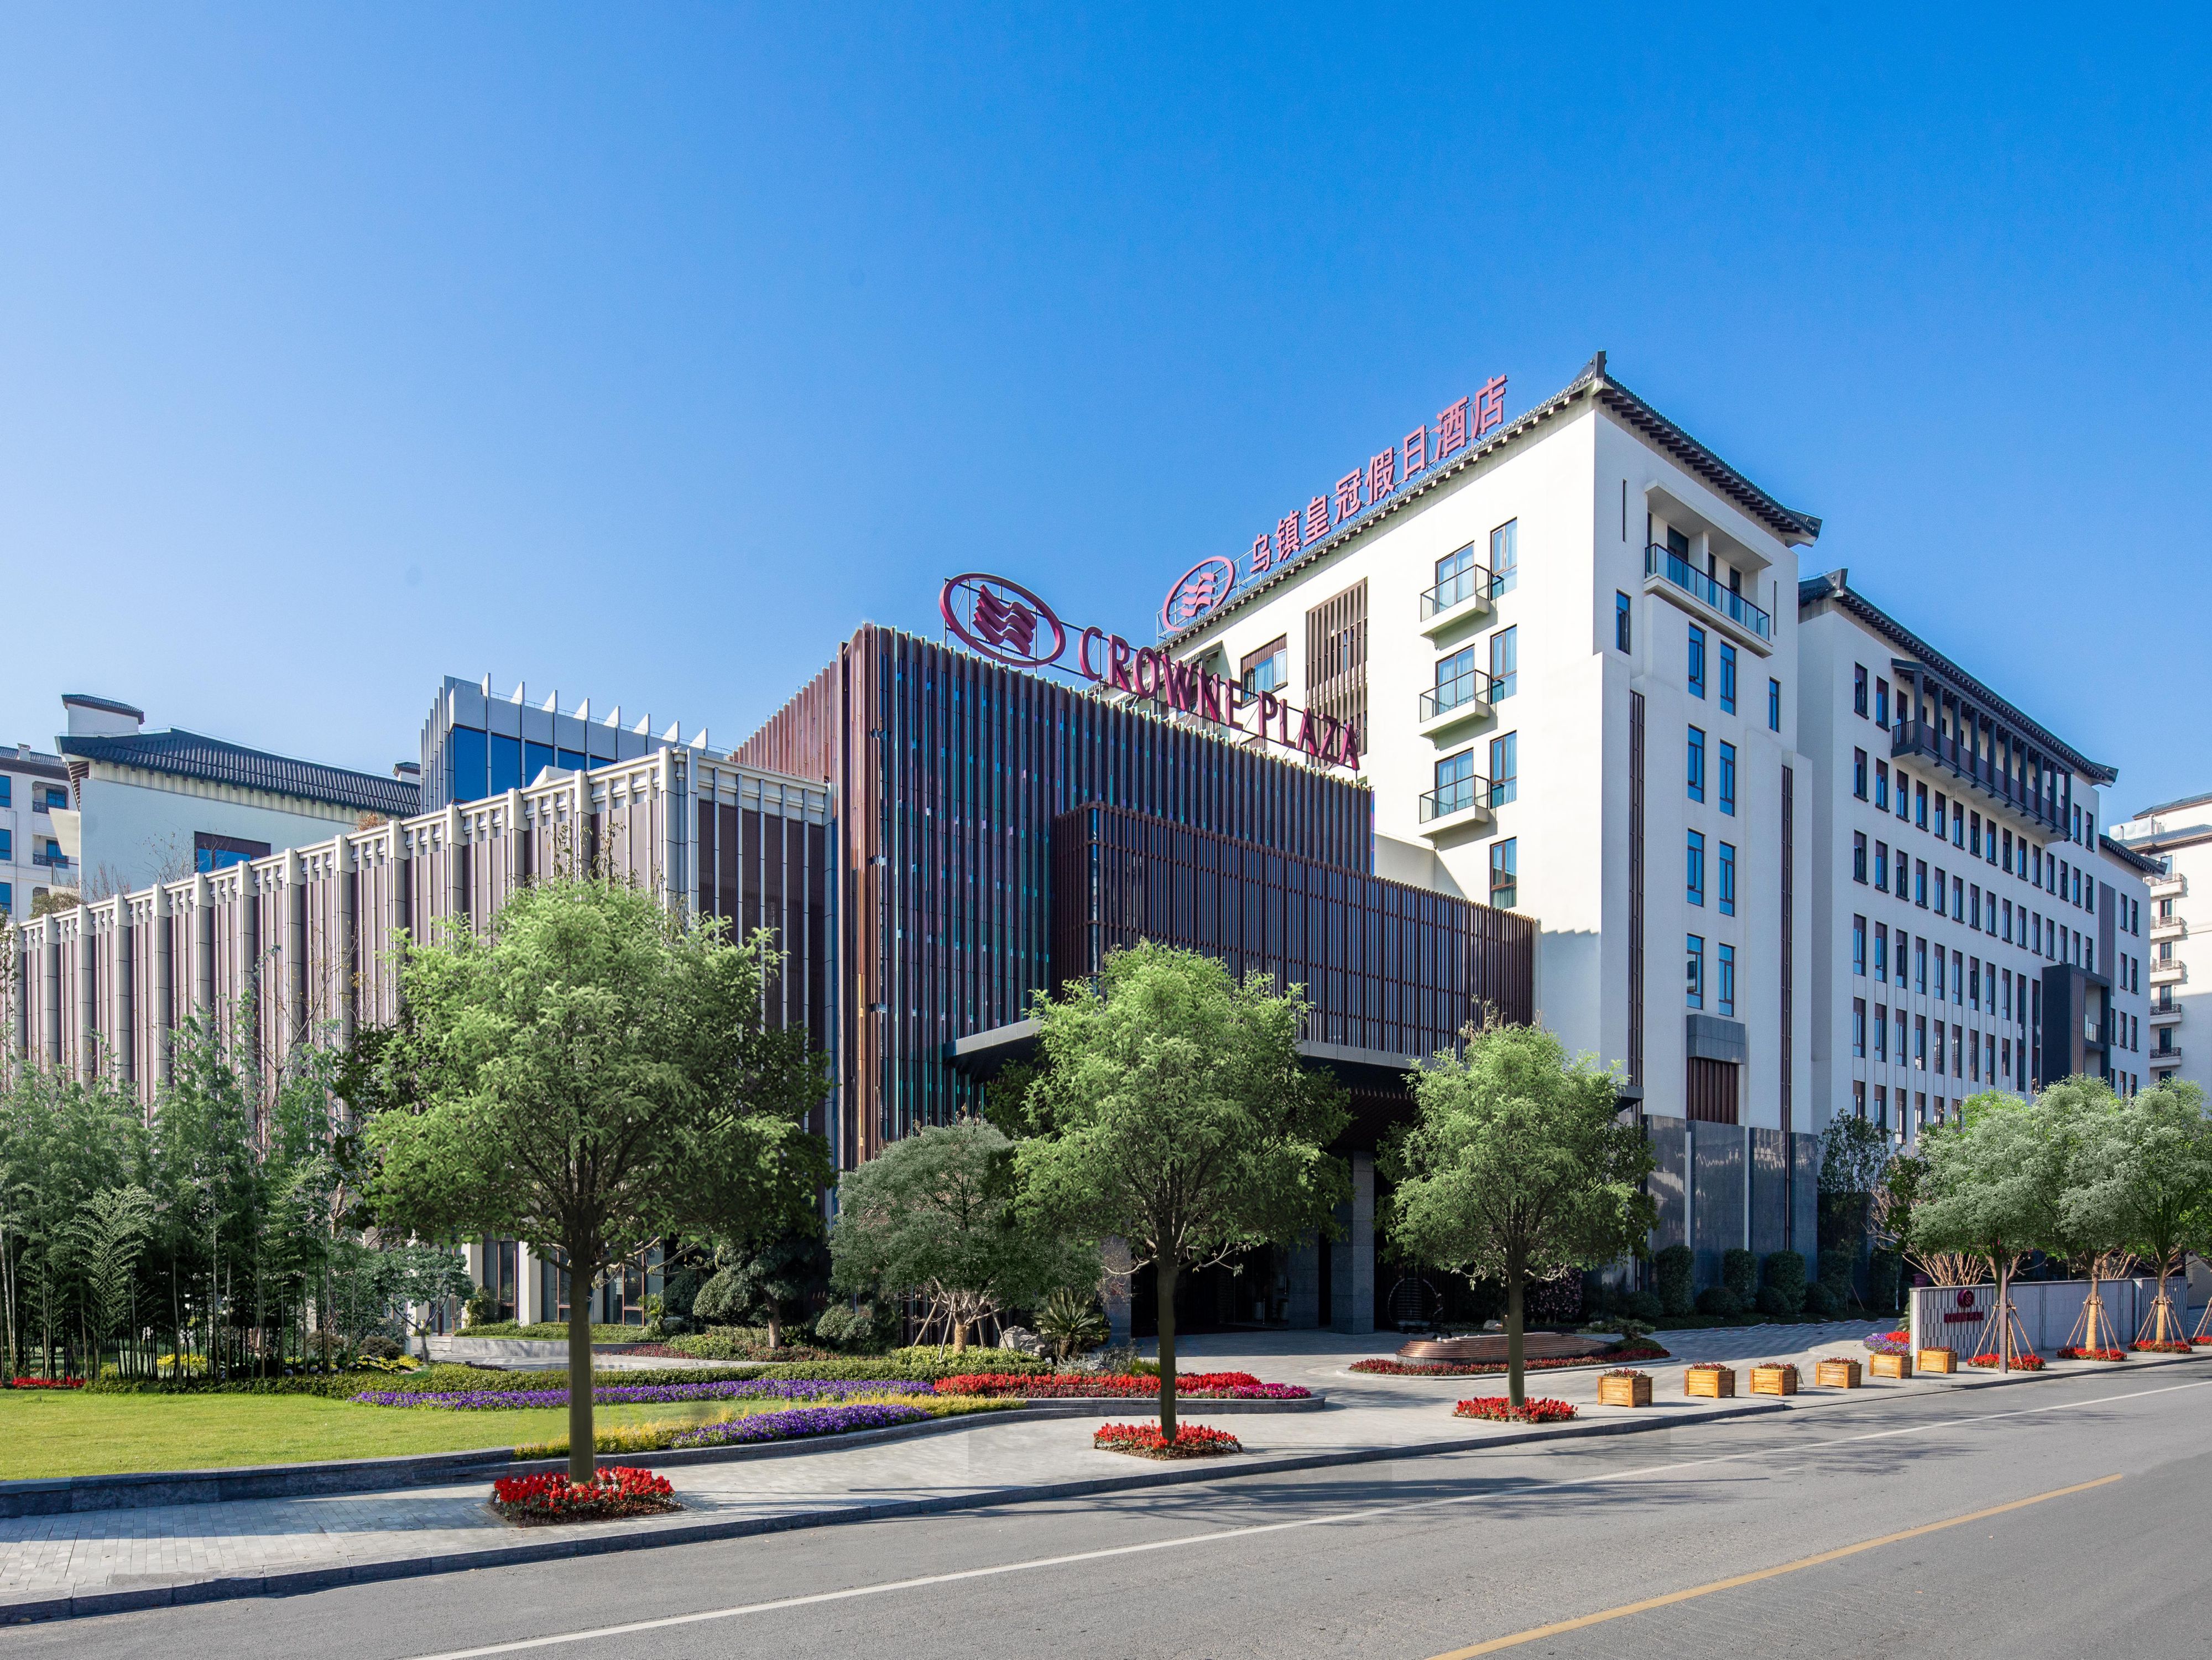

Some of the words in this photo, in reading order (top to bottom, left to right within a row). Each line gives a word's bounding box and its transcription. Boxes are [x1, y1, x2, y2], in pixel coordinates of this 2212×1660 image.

[1249, 374, 1507, 573] 乌镇皇冠假日酒店
[1079, 626, 1244, 730] CROWNE
[1258, 690, 1360, 770] PLAZA
